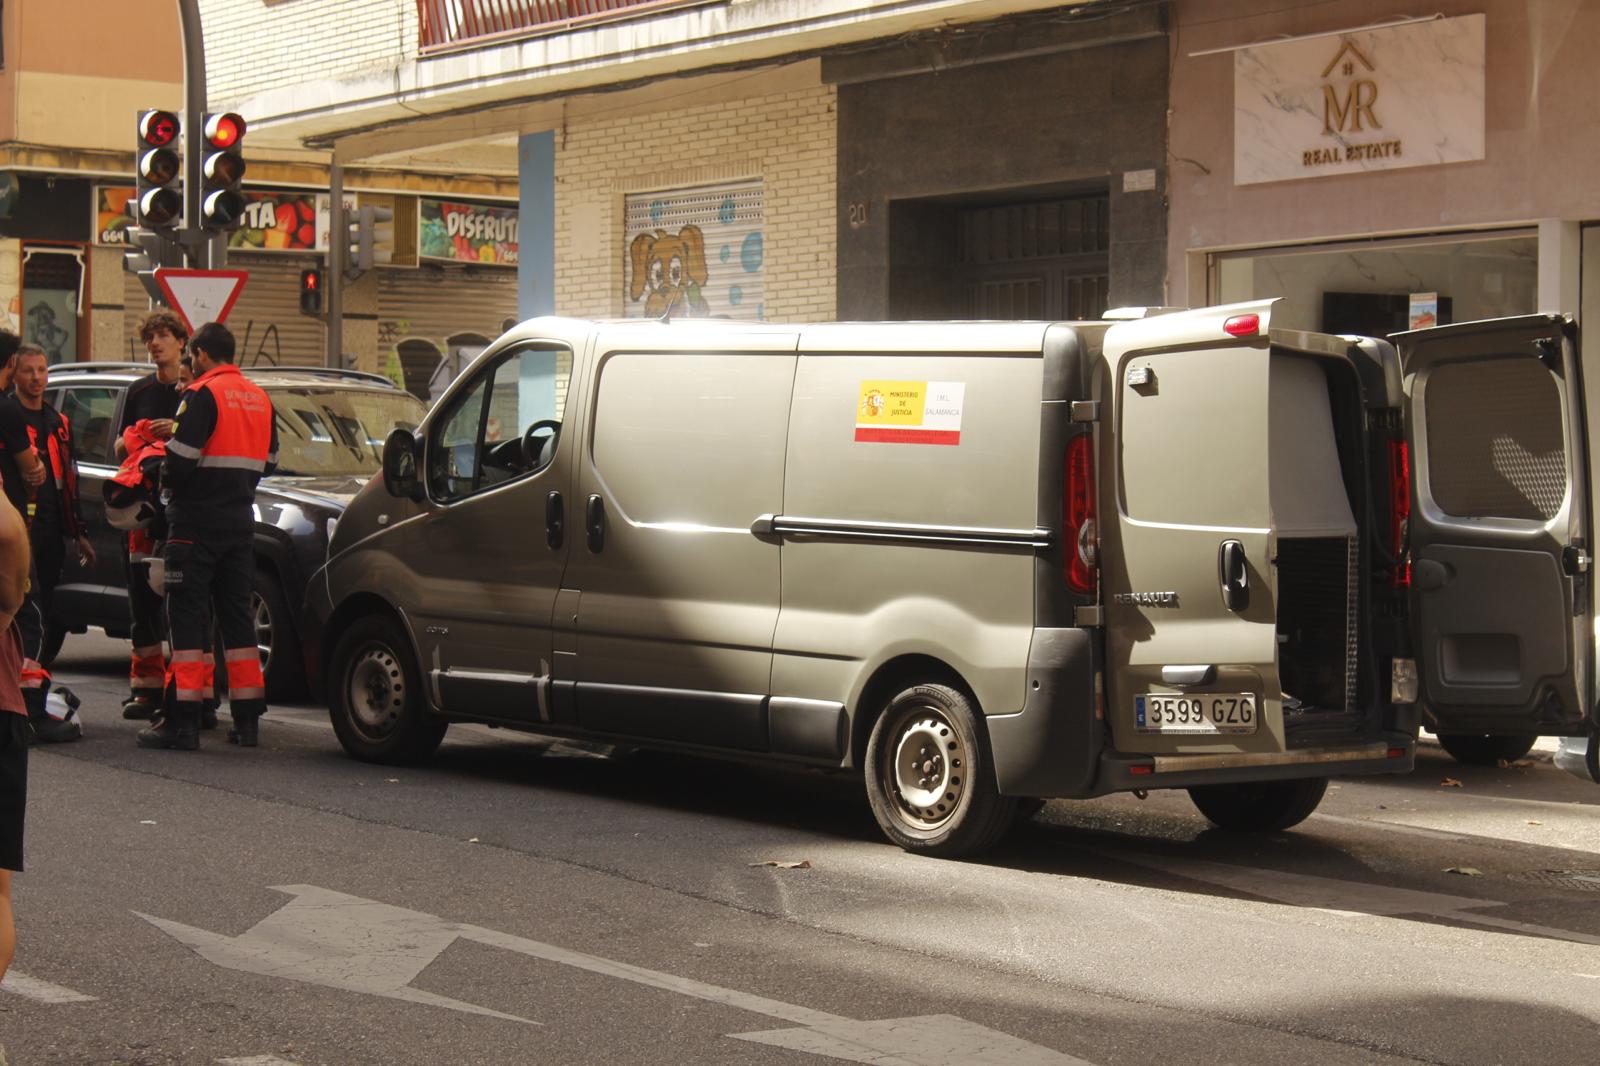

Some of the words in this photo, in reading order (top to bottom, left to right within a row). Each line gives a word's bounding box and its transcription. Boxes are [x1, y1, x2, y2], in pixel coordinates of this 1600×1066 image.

[1320, 79, 1383, 135] MR
[1303, 147, 1342, 166] REAL
[1346, 140, 1402, 161] ESTATE
[447, 212, 518, 243] DISFRUT
[1113, 591, 1176, 604] RENAULT
[1151, 700, 1203, 723] 3599
[1212, 699, 1252, 723] GZG
